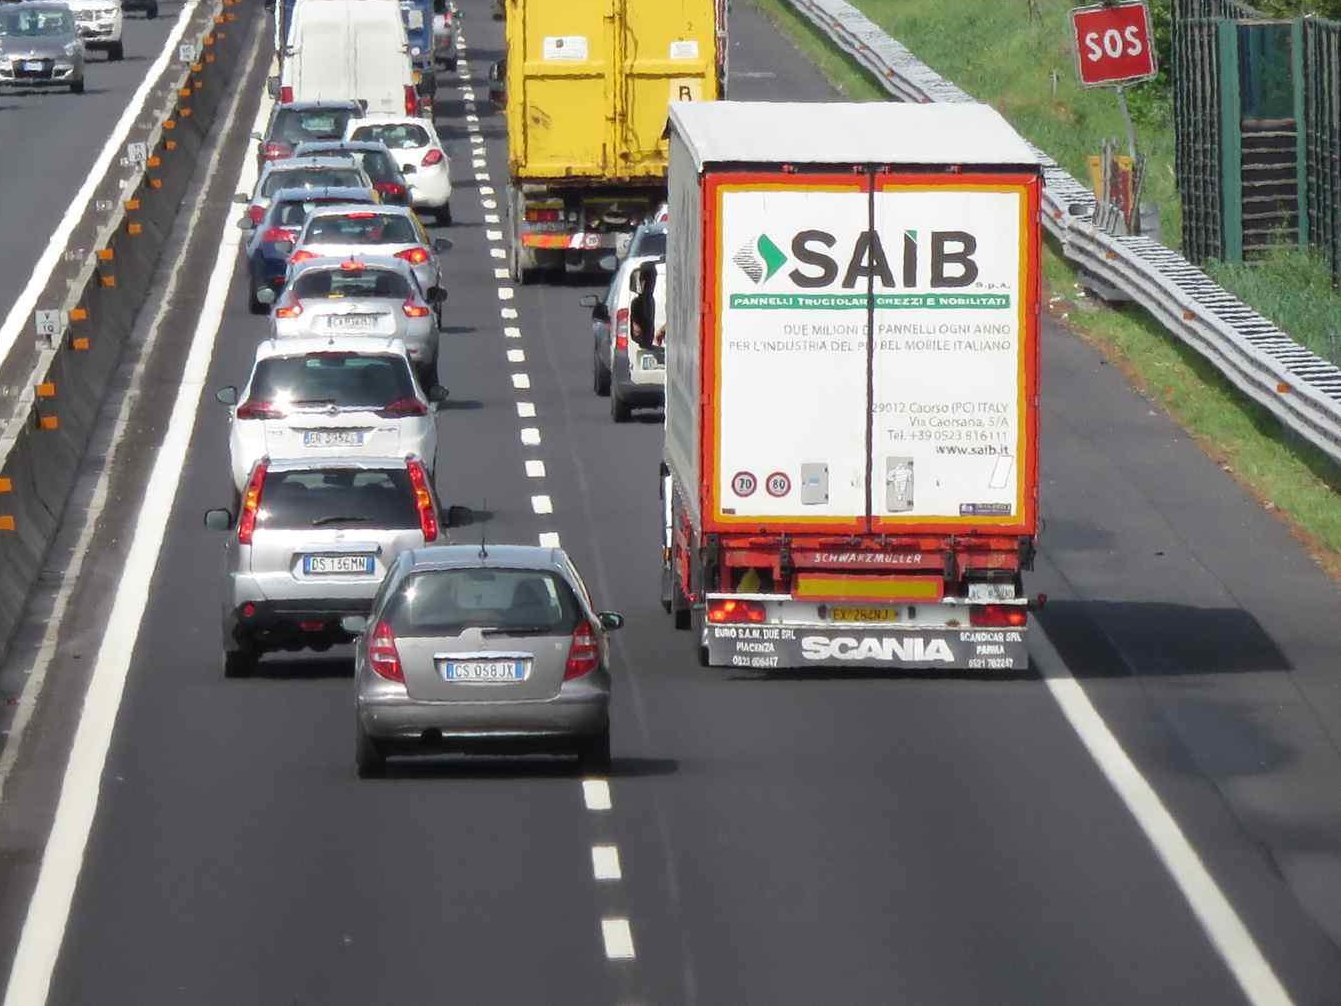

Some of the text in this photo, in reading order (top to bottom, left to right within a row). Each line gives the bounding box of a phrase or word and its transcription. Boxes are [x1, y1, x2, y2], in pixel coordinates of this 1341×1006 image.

[1084, 25, 1143, 62] SOS
[788, 229, 979, 289] SAIB
[734, 297, 1006, 306] PANNELLI TRUCIOLAR GREZZI E NOBILITATI
[784, 324, 810, 335] DUE
[811, 324, 858, 335] MILIONI
[878, 324, 935, 335] PANNELLI
[939, 324, 971, 335] OGNI
[973, 324, 1010, 335] ANNO
[729, 341, 751, 352] PER
[753, 341, 827, 352] L'INDUSTRIA
[830, 341, 853, 352] DEL
[880, 341, 902, 352] BEL
[904, 341, 949, 352] MOBILE
[953, 341, 1010, 352] ITALIANO
[909, 402, 949, 414] Caorso
[951, 402, 975, 415] (PC)
[977, 402, 1009, 414] ITALY
[909, 417, 926, 427] Via
[887, 430, 907, 441] Tel.
[936, 445, 1009, 456] www.saib.it
[738, 478, 752, 490] 70
[772, 478, 786, 490] 80
[312, 557, 326, 571] DS
[763, 629, 780, 639] DUE
[781, 629, 796, 640] SRL
[1006, 632, 1022, 642] SRL
[801, 636, 955, 663] SCANIA
